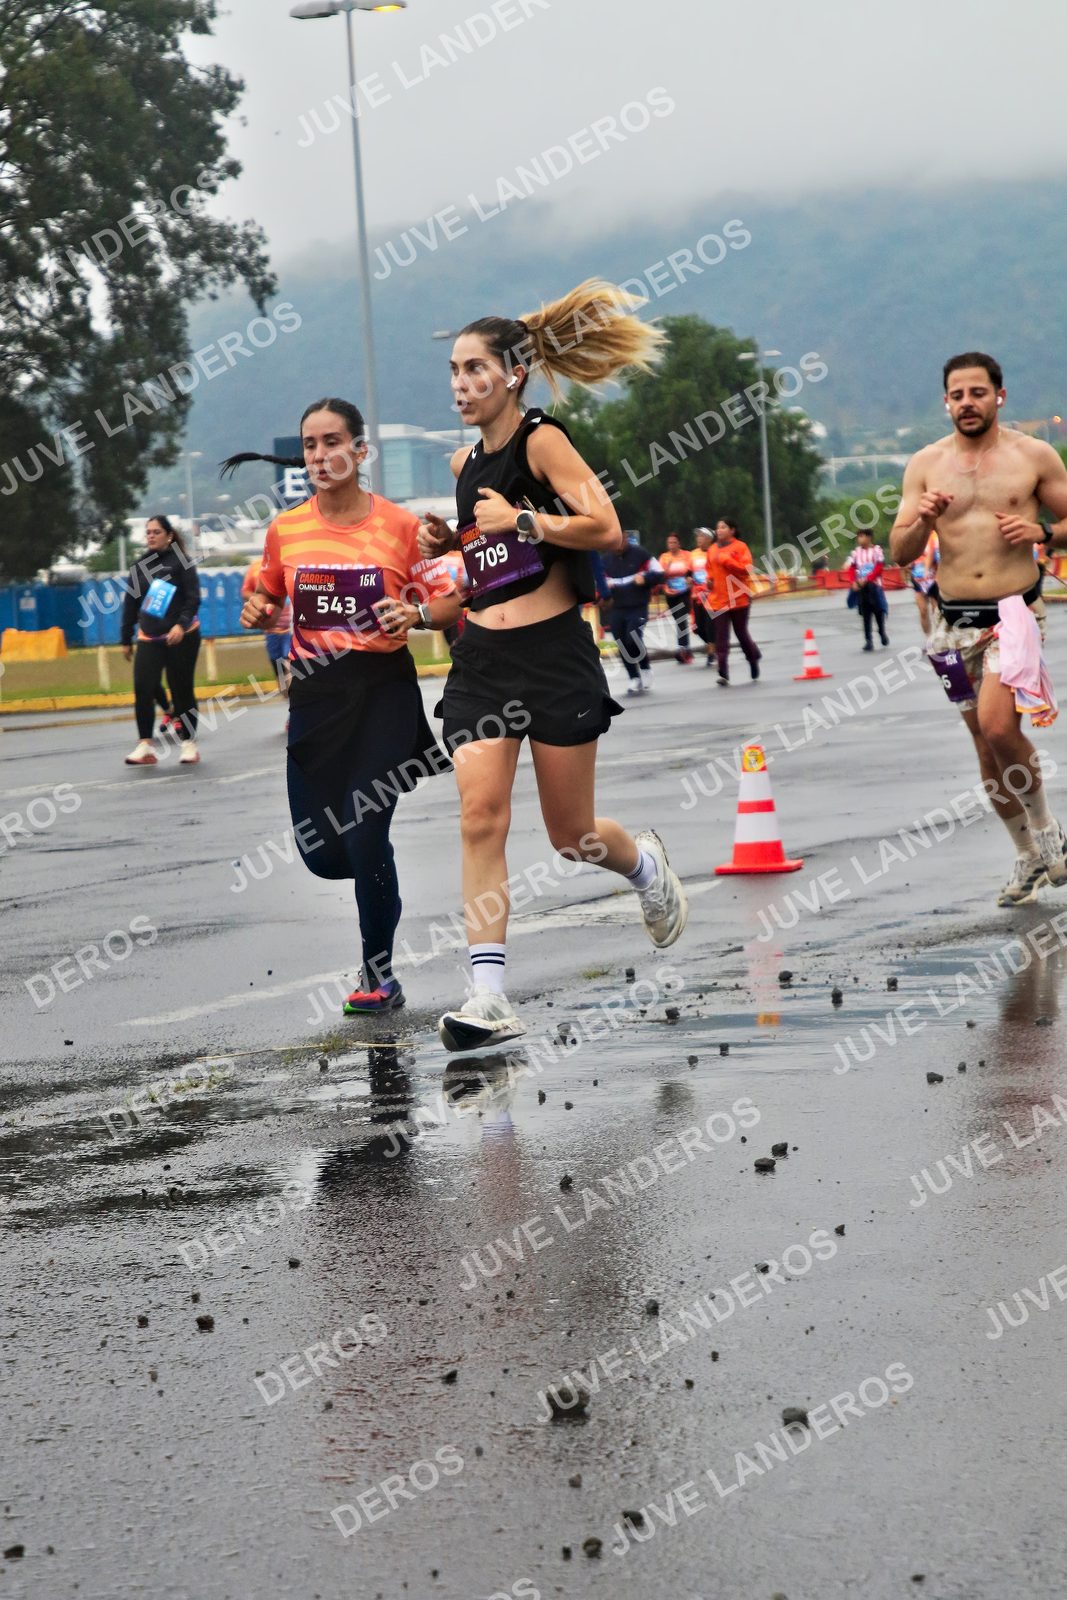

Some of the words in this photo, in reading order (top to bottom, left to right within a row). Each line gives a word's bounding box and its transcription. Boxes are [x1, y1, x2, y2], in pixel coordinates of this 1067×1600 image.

[285, 468, 307, 497] E
[475, 542, 509, 571] 709
[299, 573, 335, 583] CARRERA
[317, 595, 357, 614] 543
